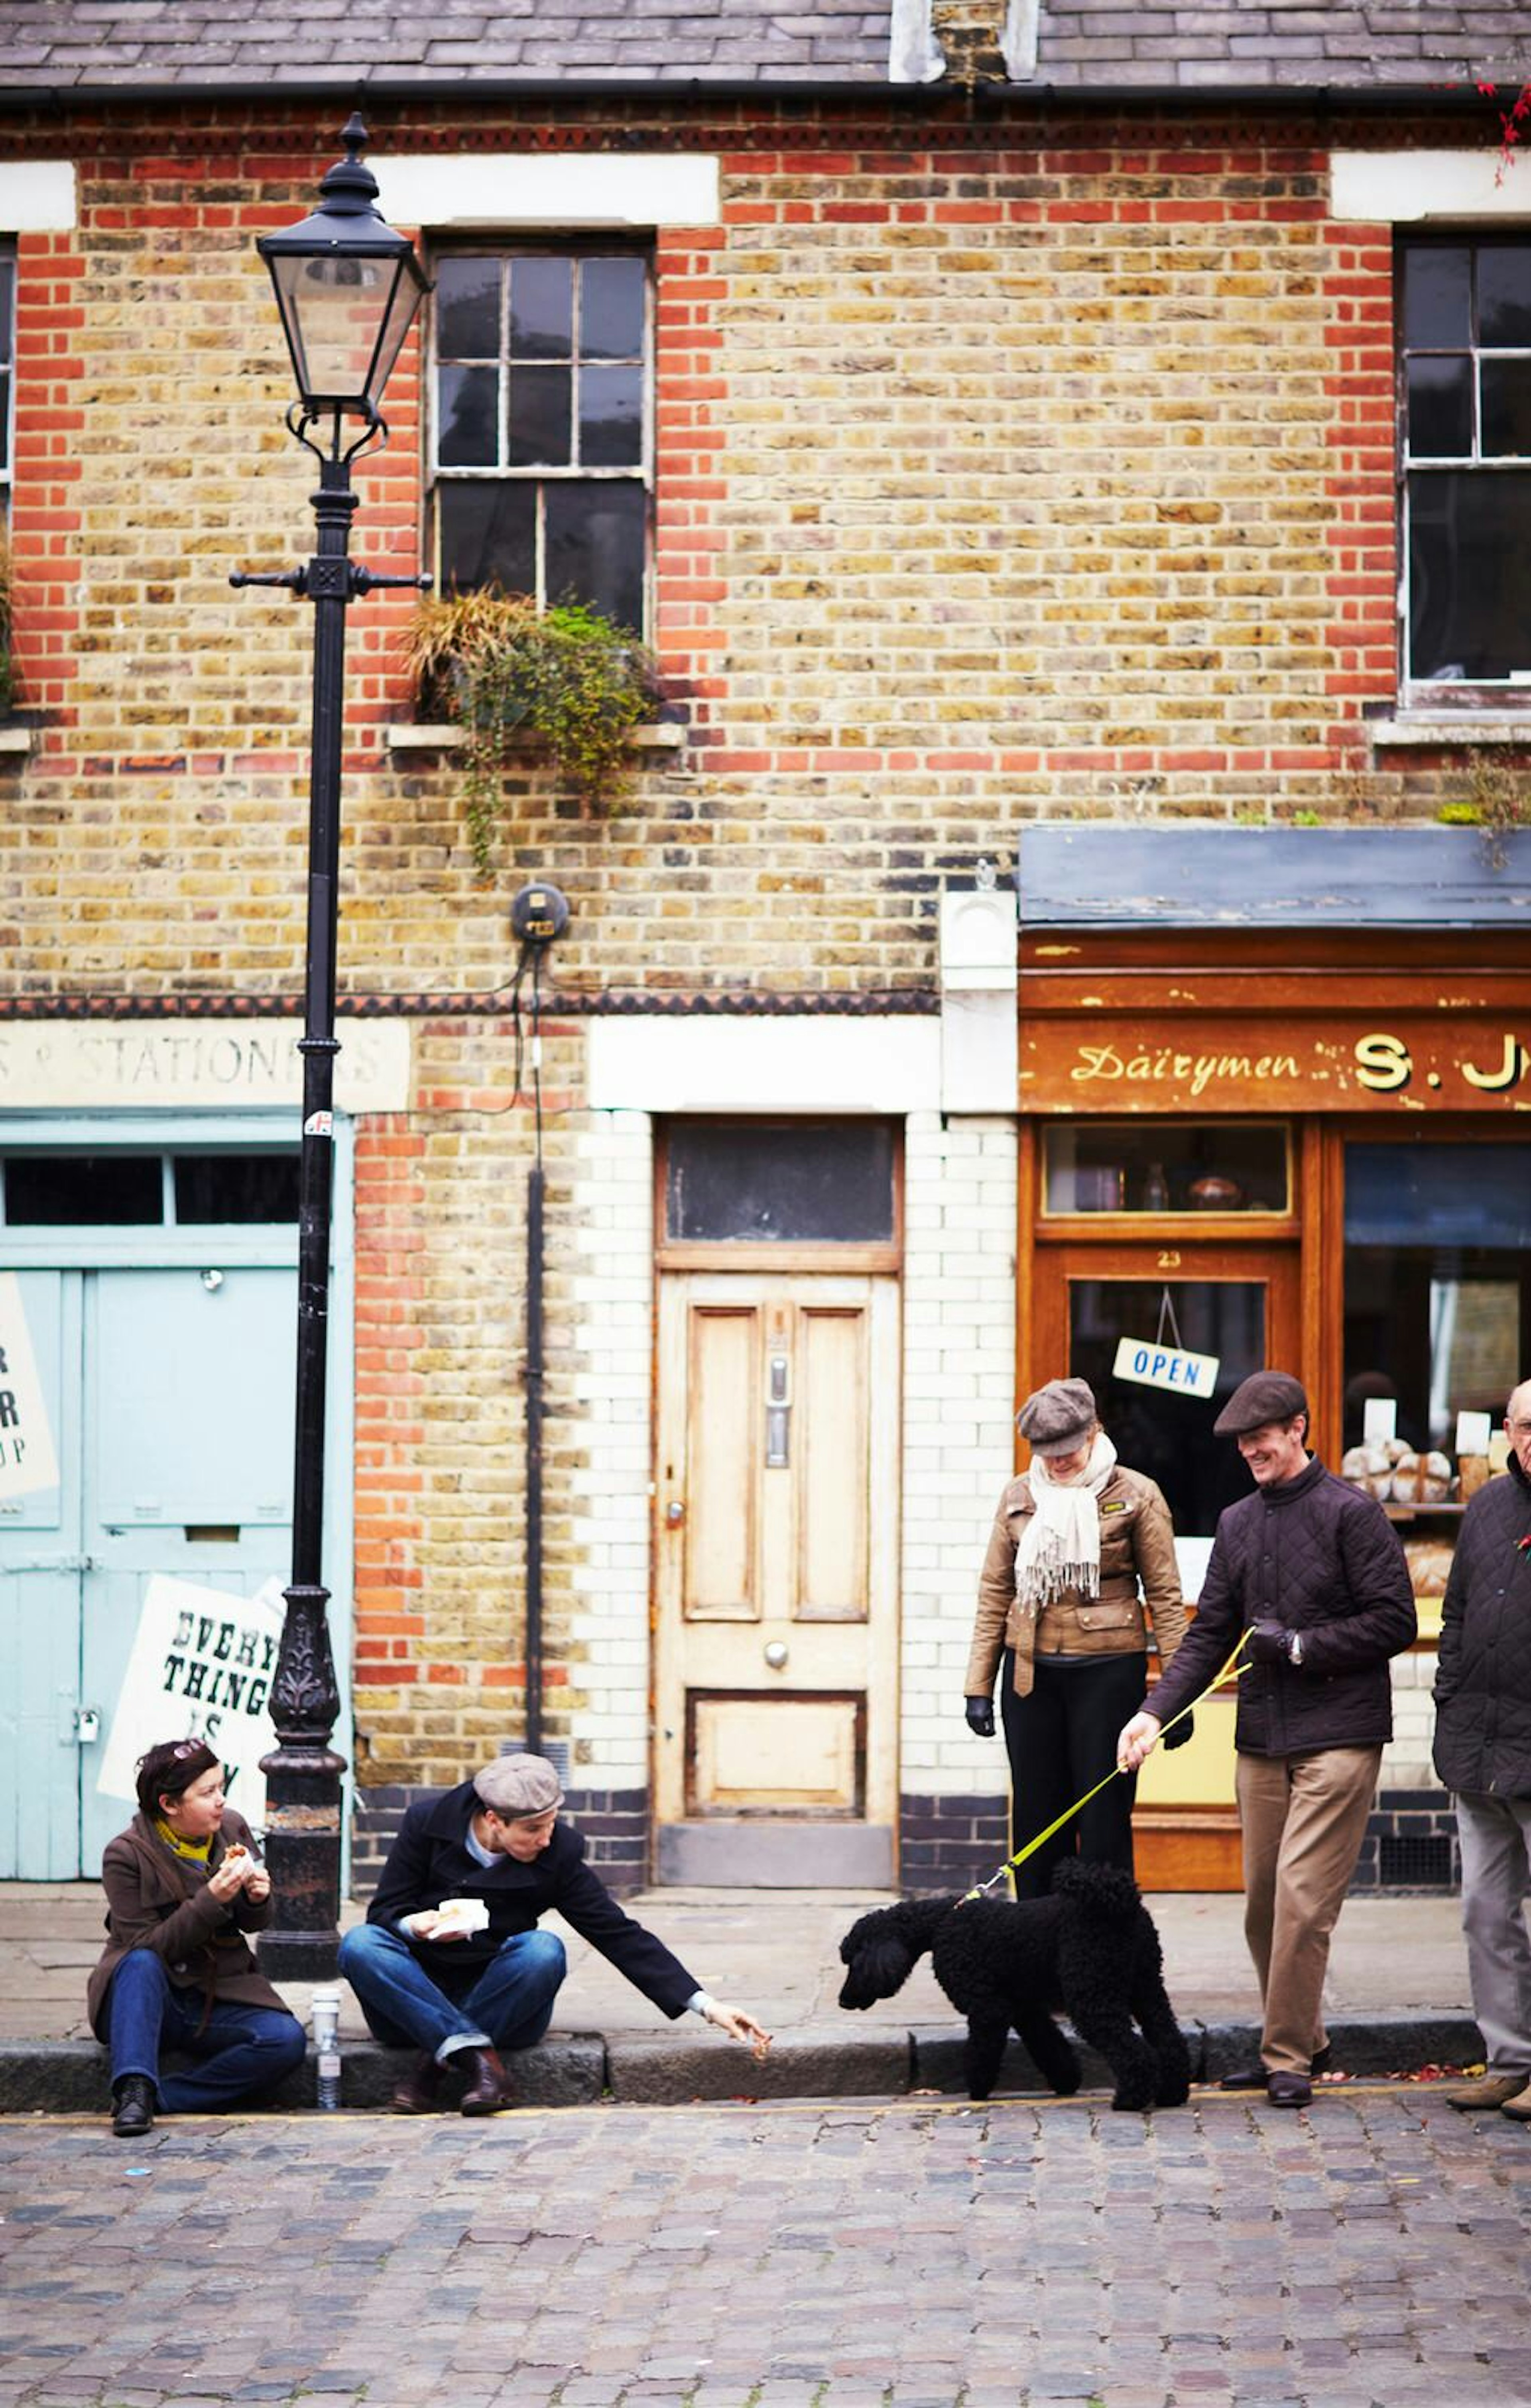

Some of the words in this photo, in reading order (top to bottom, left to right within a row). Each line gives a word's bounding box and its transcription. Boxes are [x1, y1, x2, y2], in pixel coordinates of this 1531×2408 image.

[1071, 1044, 1301, 1095] Dairymen
[1157, 1250, 1181, 1268] 23
[1134, 1349, 1200, 1386] OPEN
[172, 1610, 279, 1670] EVERY
[164, 1654, 268, 1716] THING
